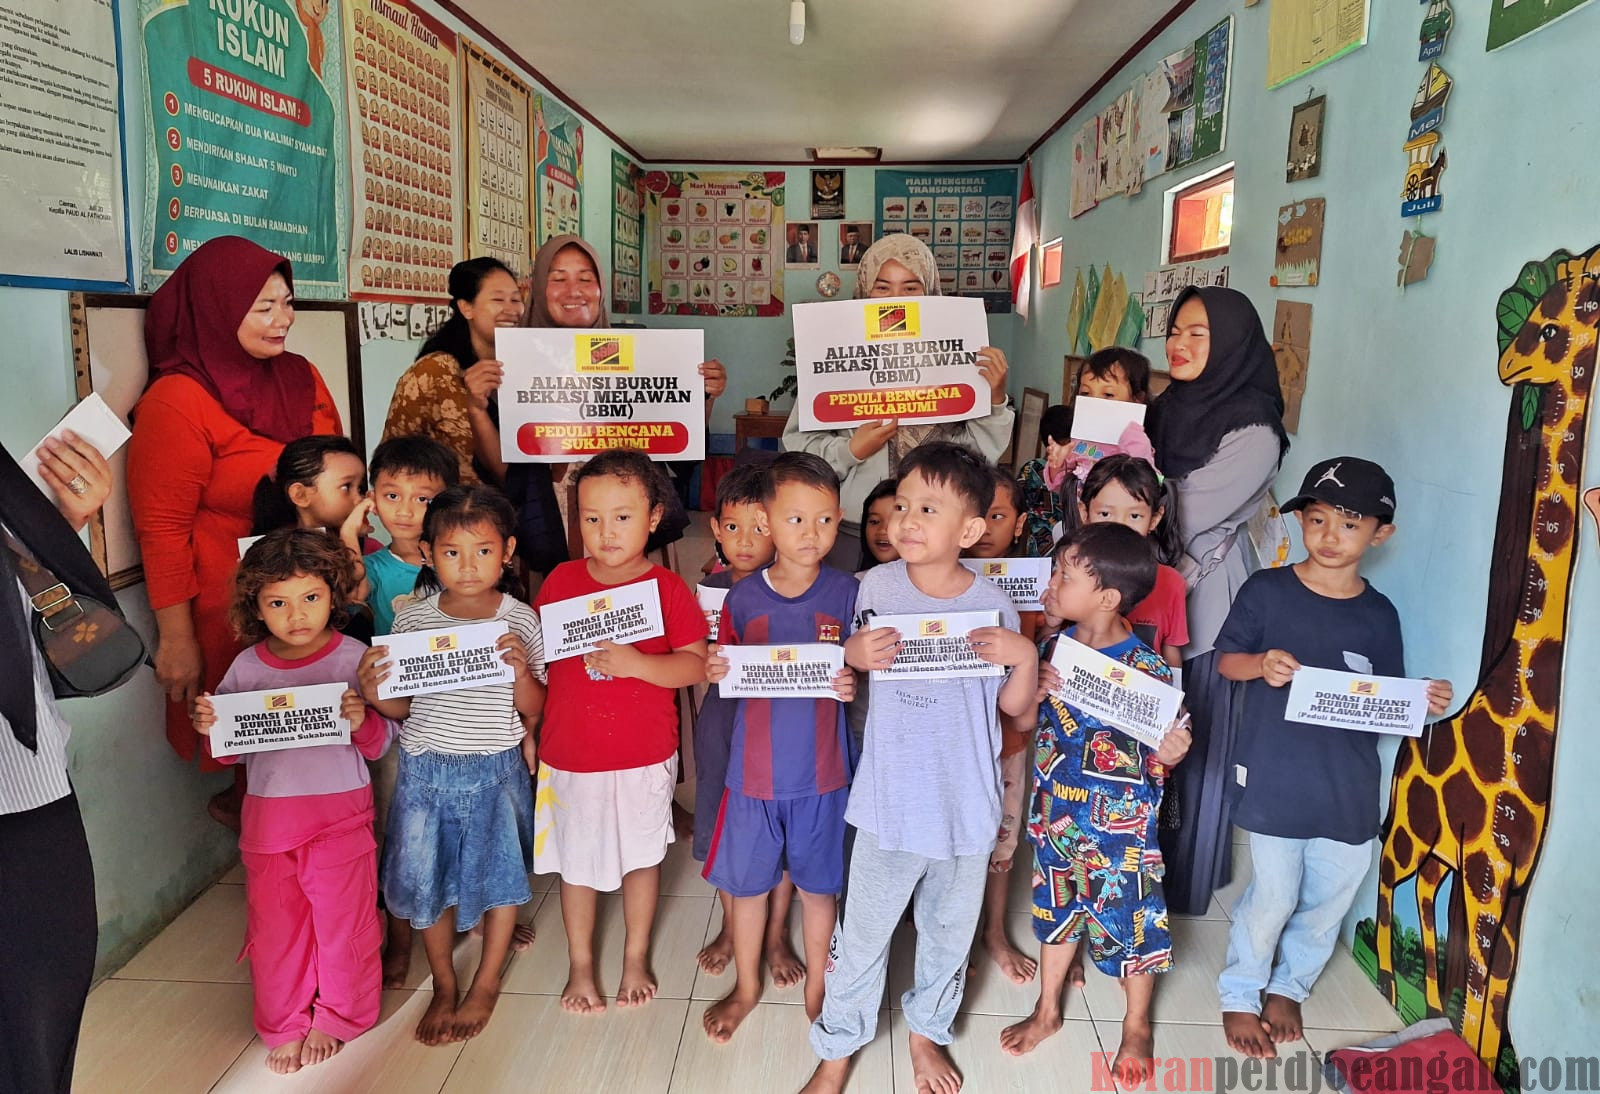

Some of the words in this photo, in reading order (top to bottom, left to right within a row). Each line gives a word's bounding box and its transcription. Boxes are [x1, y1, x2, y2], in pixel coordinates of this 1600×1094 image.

[410, 13, 439, 50] Husna
[217, 17, 285, 78] ISLAM
[1422, 43, 1442, 57] April
[203, 67, 212, 87] 5
[215, 72, 257, 105] RUKUN
[168, 99, 175, 110] 1
[184, 102, 244, 133] MENGUCAPKAN
[245, 124, 262, 139] DUA
[264, 130, 295, 147] KALIMAT
[295, 138, 328, 157] SYAHADAT
[1411, 113, 1440, 139] Mei
[170, 133, 178, 145] 2
[186, 136, 234, 161] MENDIRIKAN
[235, 153, 269, 169] SHALAT
[270, 160, 276, 169] 5
[276, 162, 298, 177] WAKTU
[173, 170, 180, 181] 3
[186, 172, 240, 195] MENUNAIKAN
[241, 184, 269, 199] ZAKAT
[707, 182, 742, 190] Mengenal
[905, 176, 932, 186] MARI
[933, 176, 987, 186] MENGENAL
[908, 185, 982, 195] TRANSPORTASI
[1408, 201, 1435, 212] Juli
[171, 202, 178, 214] 4
[184, 204, 230, 223] BERPUASA
[231, 212, 242, 225] DI
[243, 215, 267, 230] BULAN
[268, 219, 308, 235] RAMADHAN
[169, 237, 176, 249] 5
[283, 251, 302, 262] YANG
[303, 253, 325, 265] MAMPU
[1583, 301, 1599, 313] 140
[1575, 332, 1589, 343] 135
[825, 343, 901, 361] ALIANSI
[902, 339, 964, 356] BURUH
[813, 359, 879, 375] BEKASI
[882, 351, 979, 370] MELAWAN
[869, 369, 921, 387] (BBM)
[1572, 366, 1585, 379] 130
[530, 376, 611, 390] ALIANSI
[615, 376, 679, 390] BURUH
[516, 390, 590, 404] BEKASI
[593, 390, 692, 404] MELAWAN
[828, 391, 883, 406] PEDULI
[885, 386, 962, 403] BENCANA
[579, 402, 634, 420] (BBM)
[853, 400, 938, 417] SUKABUMI
[534, 425, 594, 438] PEDULI
[598, 424, 674, 438] BENCANA
[560, 437, 650, 450] SUKABUMI
[1550, 492, 1561, 504] 110
[1546, 520, 1559, 534] 105
[997, 577, 1037, 585] ALIANSI
[1537, 578, 1548, 591] 95
[1009, 590, 1039, 598] (BBM)
[562, 614, 601, 631] DONASI
[603, 603, 644, 620] ALIANSI
[1532, 609, 1542, 620] 90
[562, 625, 615, 645] MELAWAN
[617, 617, 648, 633] (BBM)
[567, 621, 602, 637] BURUH
[604, 611, 642, 627] BEKASI
[399, 653, 444, 666] DONASI
[447, 646, 495, 658] ALIANSI
[405, 660, 445, 673] BURUH
[448, 654, 491, 667] BEKASI
[399, 667, 460, 682] MELAWAN
[463, 660, 498, 674] (BBM)
[741, 664, 783, 672] DONASI
[786, 662, 831, 670] ALIANSI
[787, 669, 827, 677] BEKASI
[389, 680, 420, 693] (Peduli
[422, 677, 458, 688] Bencana
[741, 677, 798, 685] MELAWAN
[1072, 665, 1112, 690] DONASI
[1074, 674, 1109, 697] BURUH
[1314, 691, 1360, 703] DONASI
[1363, 697, 1411, 708] ALIANSI
[1318, 699, 1359, 710] BURUH
[1362, 704, 1405, 714] BEKASI
[234, 712, 280, 723] DONASI
[283, 706, 333, 718] ALIANSI
[1048, 695, 1079, 738] MARVEL
[1297, 711, 1328, 722] (Peduli
[1330, 715, 1367, 725] Bencana
[1310, 704, 1372, 718] MELAWAN
[1374, 711, 1410, 722] (BBM)
[234, 726, 297, 738] MELAWAN
[300, 719, 337, 733] (BBM)
[240, 720, 281, 730] BURUH
[284, 714, 330, 726] BEKASI
[224, 738, 256, 749] (Peduli
[258, 735, 296, 744] Bencana
[1512, 751, 1522, 765] 65
[1053, 779, 1090, 803] MARV
[1505, 805, 1516, 821] 55
[1500, 833, 1510, 847] 50
[1486, 912, 1495, 925] 35
[1482, 934, 1491, 948] 30
[1474, 989, 1483, 1001] 20
